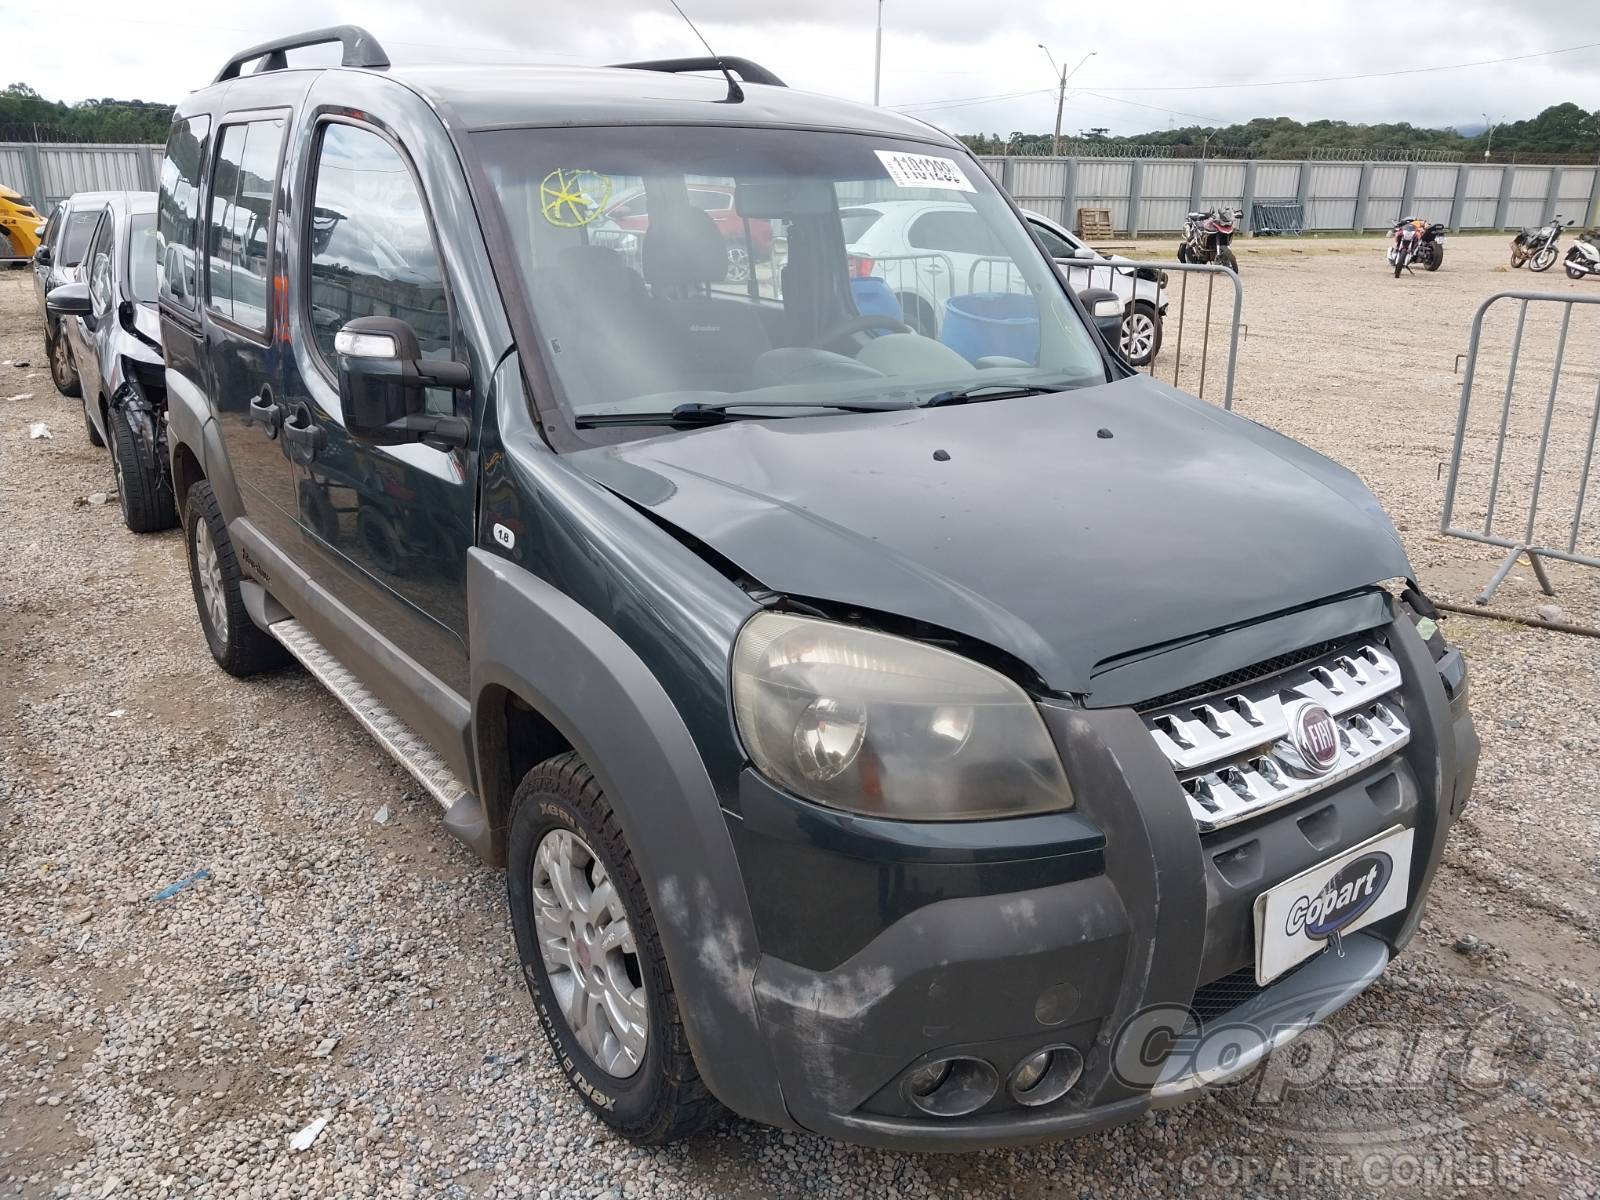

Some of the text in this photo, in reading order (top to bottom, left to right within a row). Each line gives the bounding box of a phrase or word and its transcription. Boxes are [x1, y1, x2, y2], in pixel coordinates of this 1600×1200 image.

[1307, 719, 1334, 753] FIAT
[1285, 863, 1378, 936] Copart
[540, 1004, 576, 1073] Brutus
